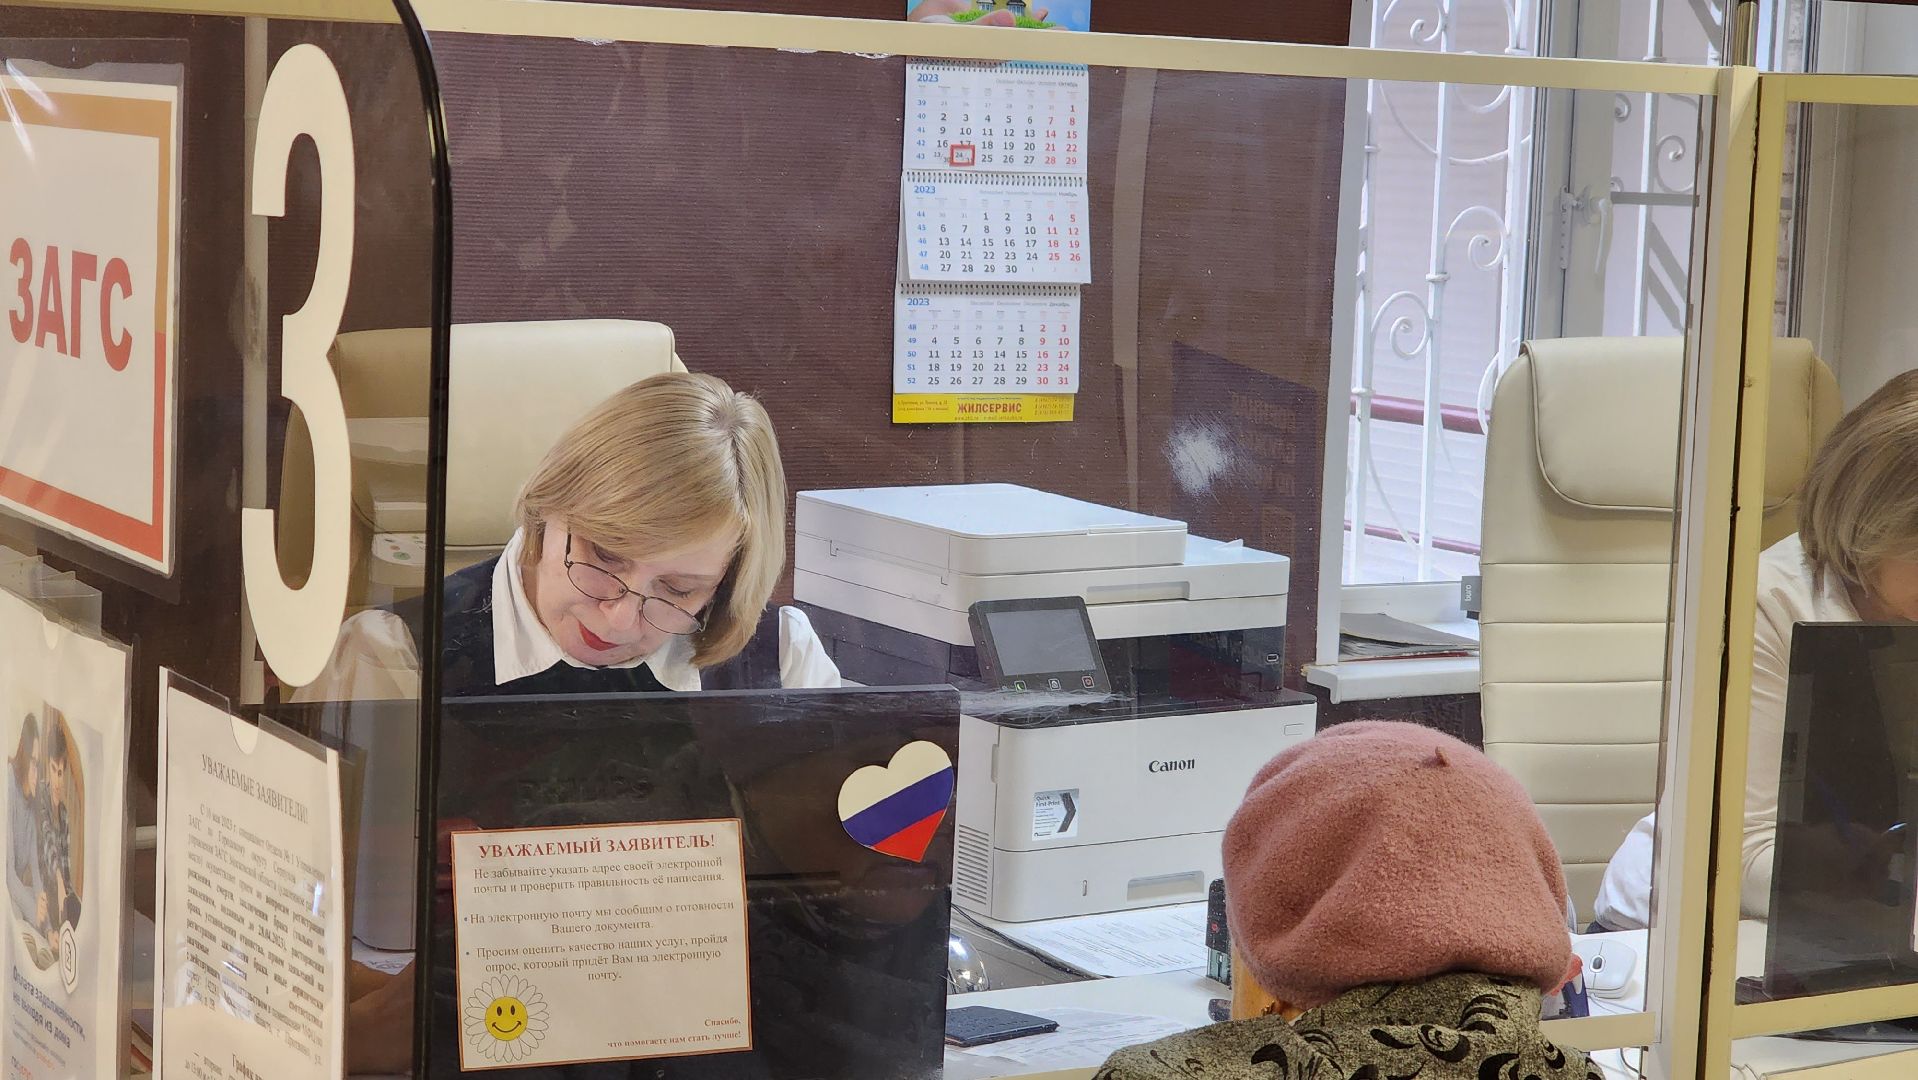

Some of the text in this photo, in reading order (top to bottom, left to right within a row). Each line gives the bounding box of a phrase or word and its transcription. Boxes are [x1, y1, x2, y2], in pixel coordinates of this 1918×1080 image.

[916, 73, 939, 82] 2023
[1070, 105, 1075, 113] 1
[940, 113, 1076, 126] 2 3 4 5 6 7 8
[940, 126, 1078, 140] 9 10 11 12 13 14 15
[937, 140, 1077, 153] 16 18 19 20 21 22
[914, 185, 936, 194] 2023
[984, 212, 1076, 223] 1 2 3 4 5
[940, 224, 1079, 236] 6 7 8 9 10 11 12
[939, 237, 1080, 248] 13 14 15 16 17 18 19
[940, 250, 1081, 262] 20 21 22 23 24 25 26
[940, 263, 1018, 274] 27 28 29 30
[9, 237, 133, 372] ЗАГС
[906, 298, 930, 306] 2023
[1020, 324, 1067, 333] 1 2 3
[932, 336, 1070, 346] 4 5 6 7 8 9 10
[929, 350, 1070, 359] 11 12 13 14 15 16 17
[242, 43, 356, 687] 3
[929, 363, 1070, 372] 18 19 20 21 22 23 24
[928, 376, 1069, 385] 25 26 27 28 29 30 31
[957, 402, 1022, 413] ЖИЛСЕРВИС
[1148, 758, 1196, 773] Canon
[202, 754, 254, 798] УВАЖАЕМЫЕ
[479, 834, 715, 859] УВАЖАЕМЫЙ ЗАЯВИТЕЛЬ!
[474, 857, 723, 879] Не забывайте указать адрес своей электронной
[474, 884, 507, 894] почты
[510, 883, 518, 891] и
[520, 880, 575, 893] проверить
[578, 876, 650, 890] правильность
[652, 874, 664, 884] её
[470, 913, 486, 924] На
[488, 908, 560, 924] электронную
[562, 907, 593, 920] почту
[595, 908, 612, 917] мы
[614, 904, 663, 917] сообщим
[675, 901, 734, 913] готовности
[551, 920, 654, 936] Вашего документа.
[477, 934, 728, 958] Просим оценить качество наших услуг, пройдя
[485, 948, 721, 974] опрос, который придёт Вам на электронную
[588, 970, 622, 982] почту.
[44, 1019, 53, 1034] из
